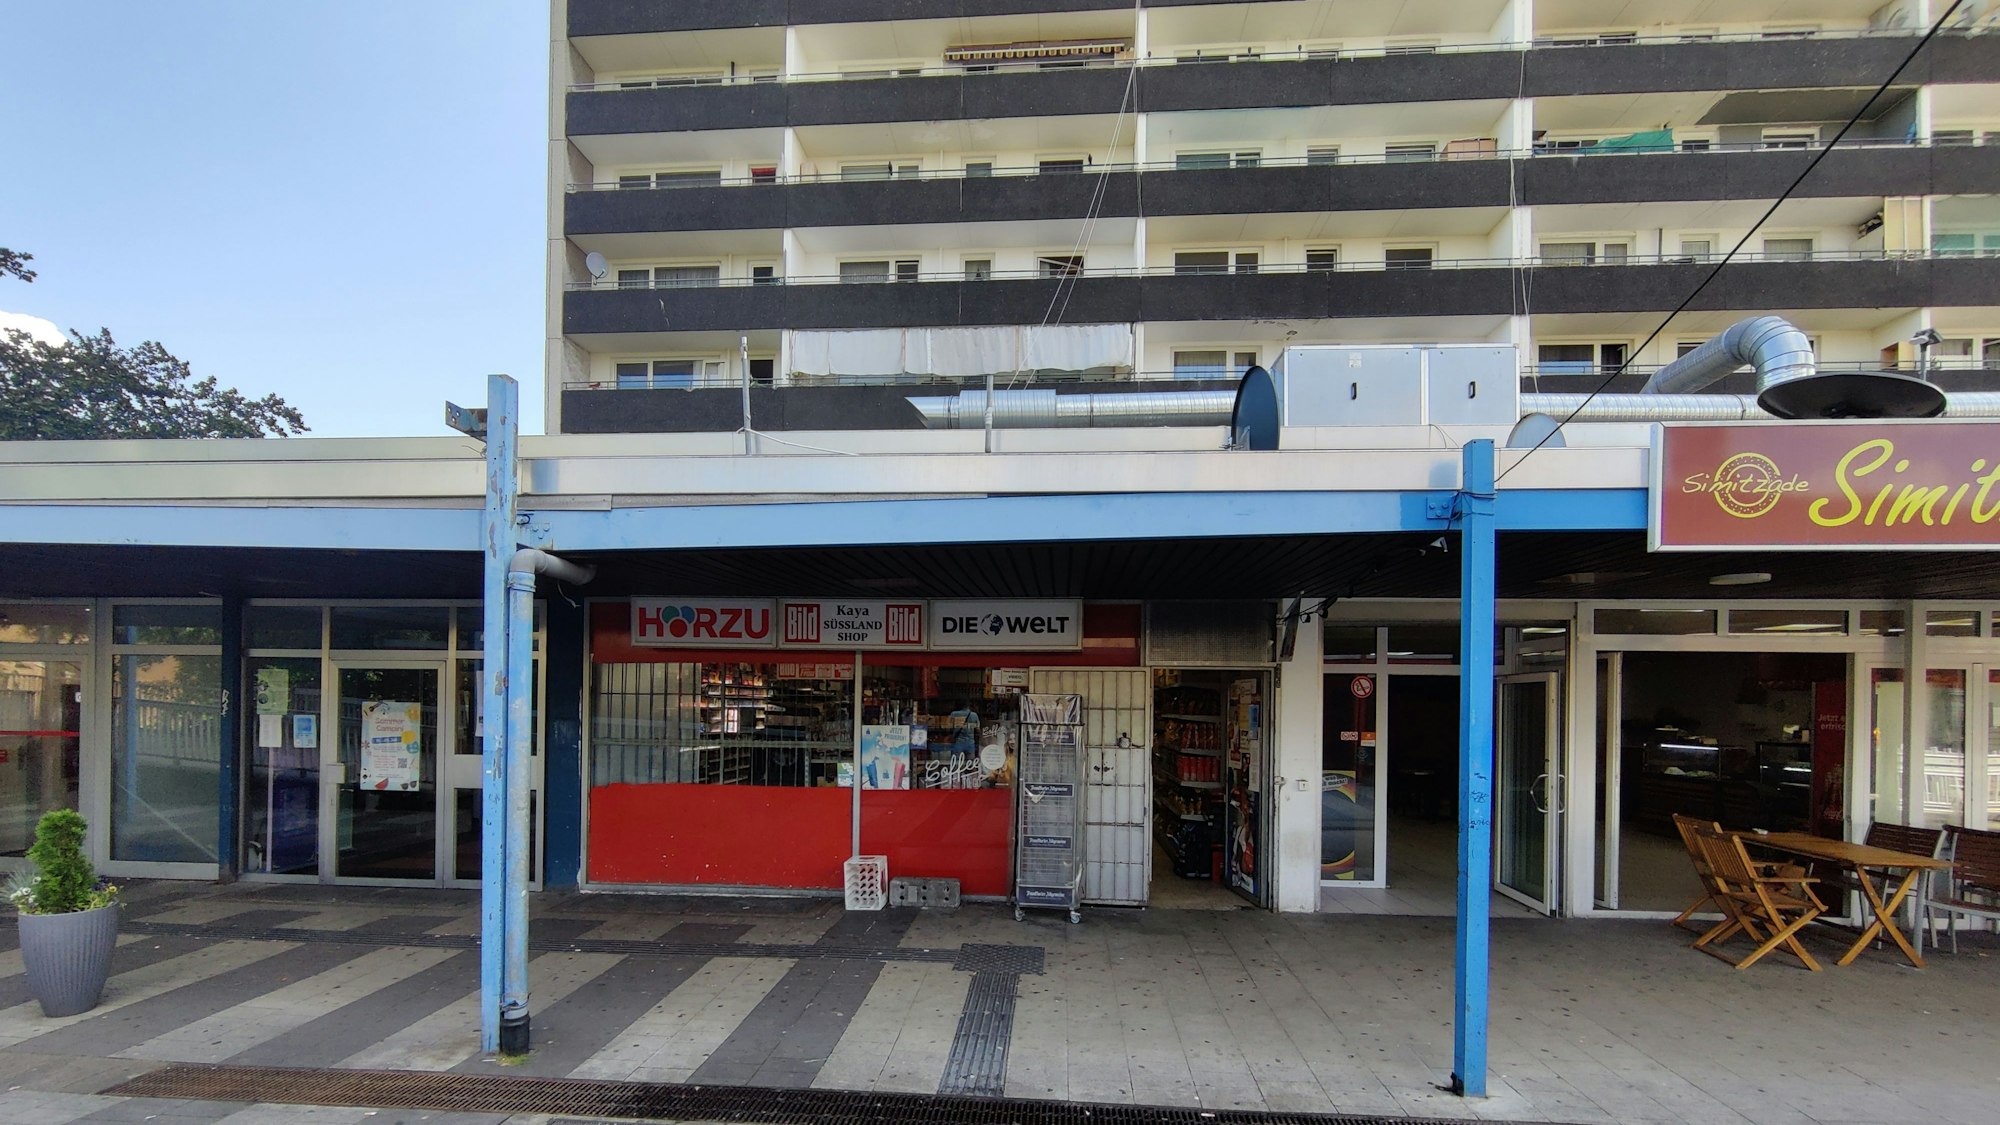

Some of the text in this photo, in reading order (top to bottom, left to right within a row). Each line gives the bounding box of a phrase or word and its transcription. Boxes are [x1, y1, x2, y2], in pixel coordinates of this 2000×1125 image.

[1682, 472, 1809, 494] Simitzade
[1808, 438, 2000, 527] Simit
[836, 605, 869, 618] Kaya
[787, 606, 818, 640] Bild
[823, 618, 883, 631] SÜSSLAND
[888, 606, 919, 640] Bild
[942, 616, 978, 634] DIE
[837, 632, 868, 642] SHOP
[1820, 721, 1846, 731] erfrisc
[925, 752, 980, 785] Coffee
